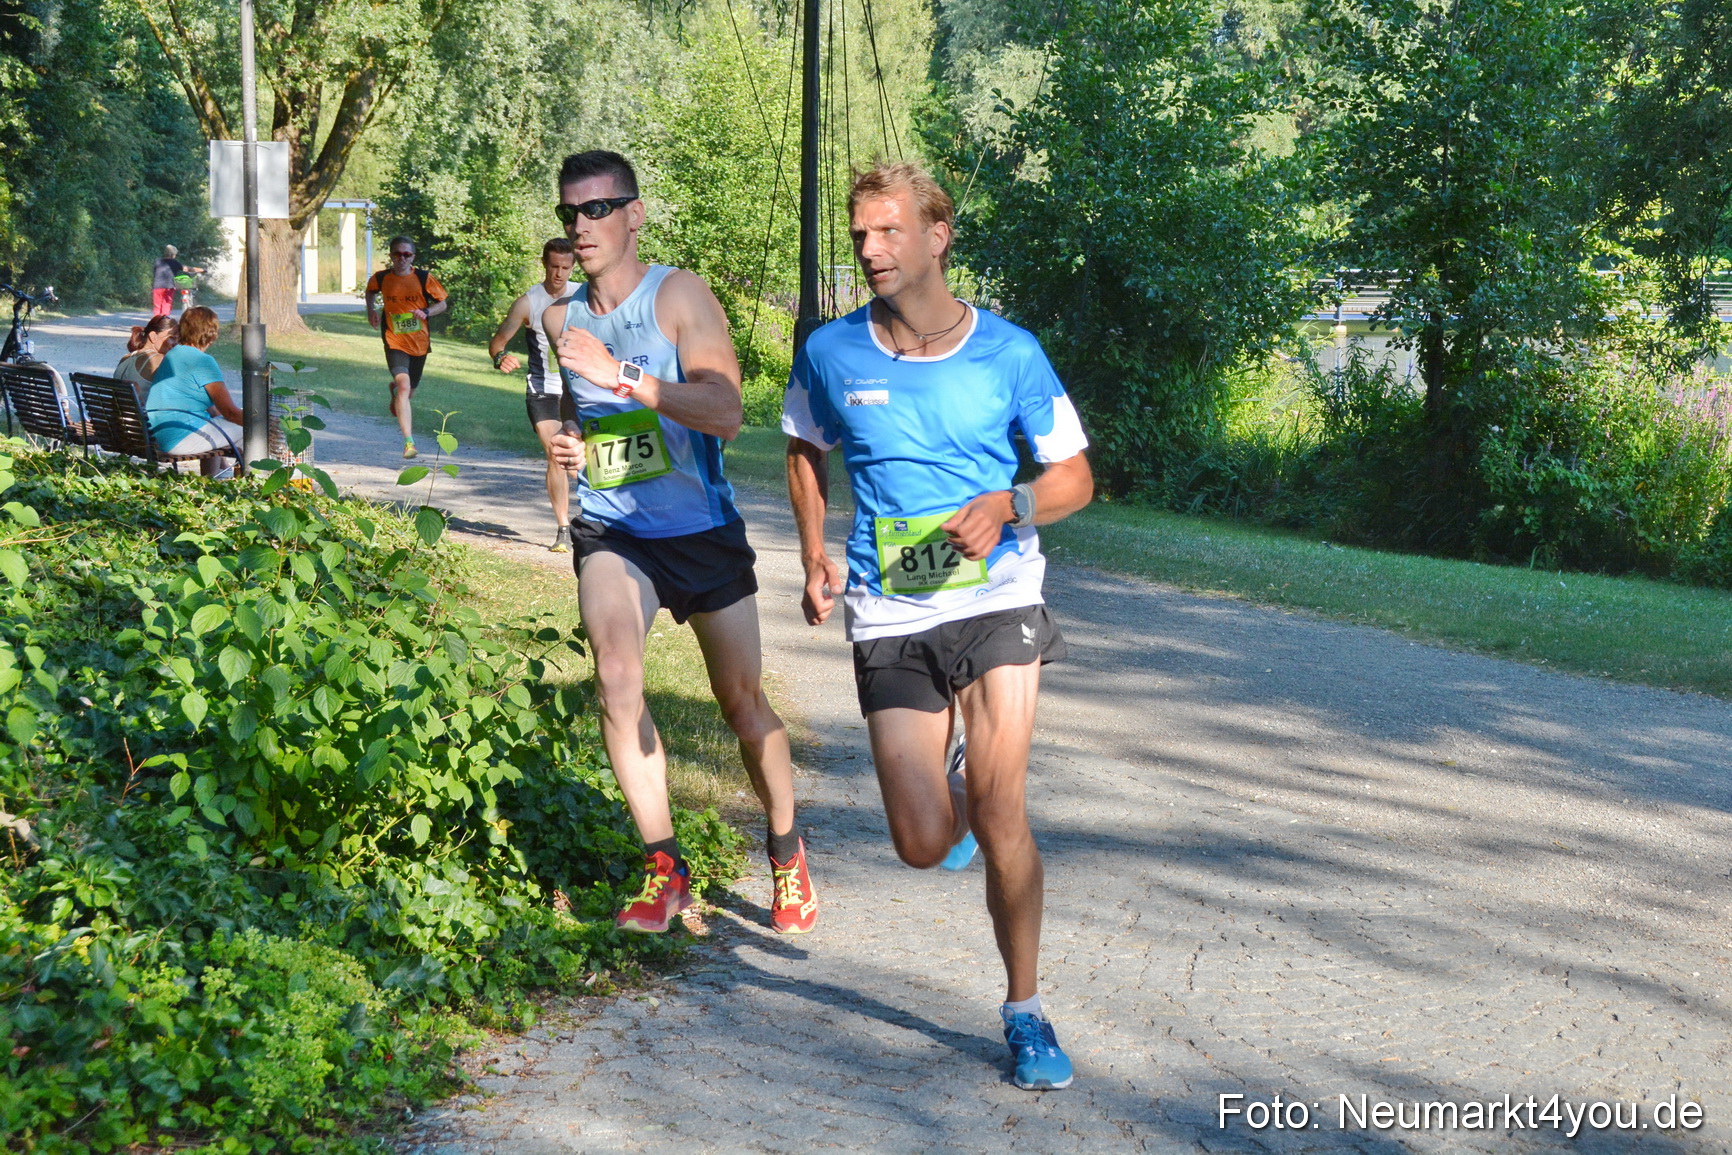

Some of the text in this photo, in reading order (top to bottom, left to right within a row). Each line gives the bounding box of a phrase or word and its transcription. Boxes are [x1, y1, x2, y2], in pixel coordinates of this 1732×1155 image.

[396, 319, 418, 328] 1488
[592, 433, 654, 468] 1775
[604, 462, 644, 475] Benz Marco
[900, 541, 960, 573] 812
[906, 569, 960, 581] Lang Michael
